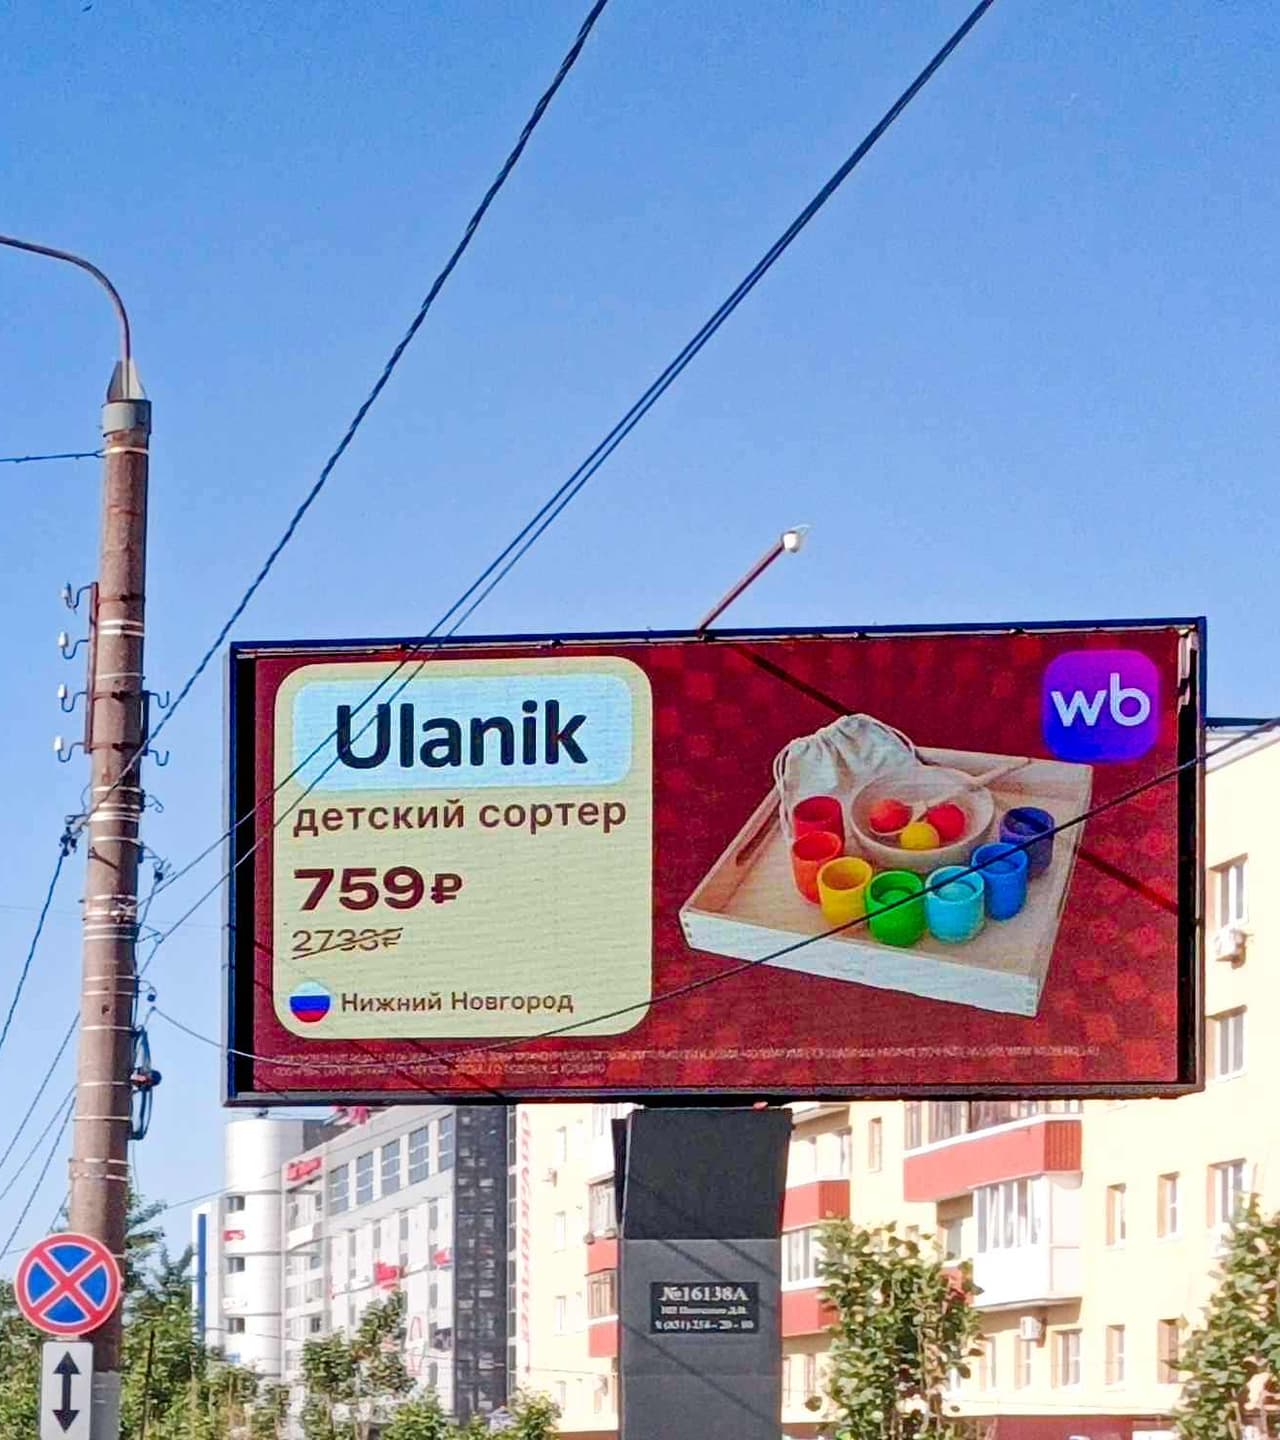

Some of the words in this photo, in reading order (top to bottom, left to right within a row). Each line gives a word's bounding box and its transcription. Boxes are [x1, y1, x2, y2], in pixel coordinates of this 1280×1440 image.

[1050, 672, 1151, 727] wb
[336, 699, 589, 769] Ulanik
[293, 799, 465, 838] детский
[478, 801, 627, 834] сортер
[293, 865, 464, 912] 759₽
[340, 991, 442, 1013] Нижний
[451, 991, 574, 1014] Новгород
